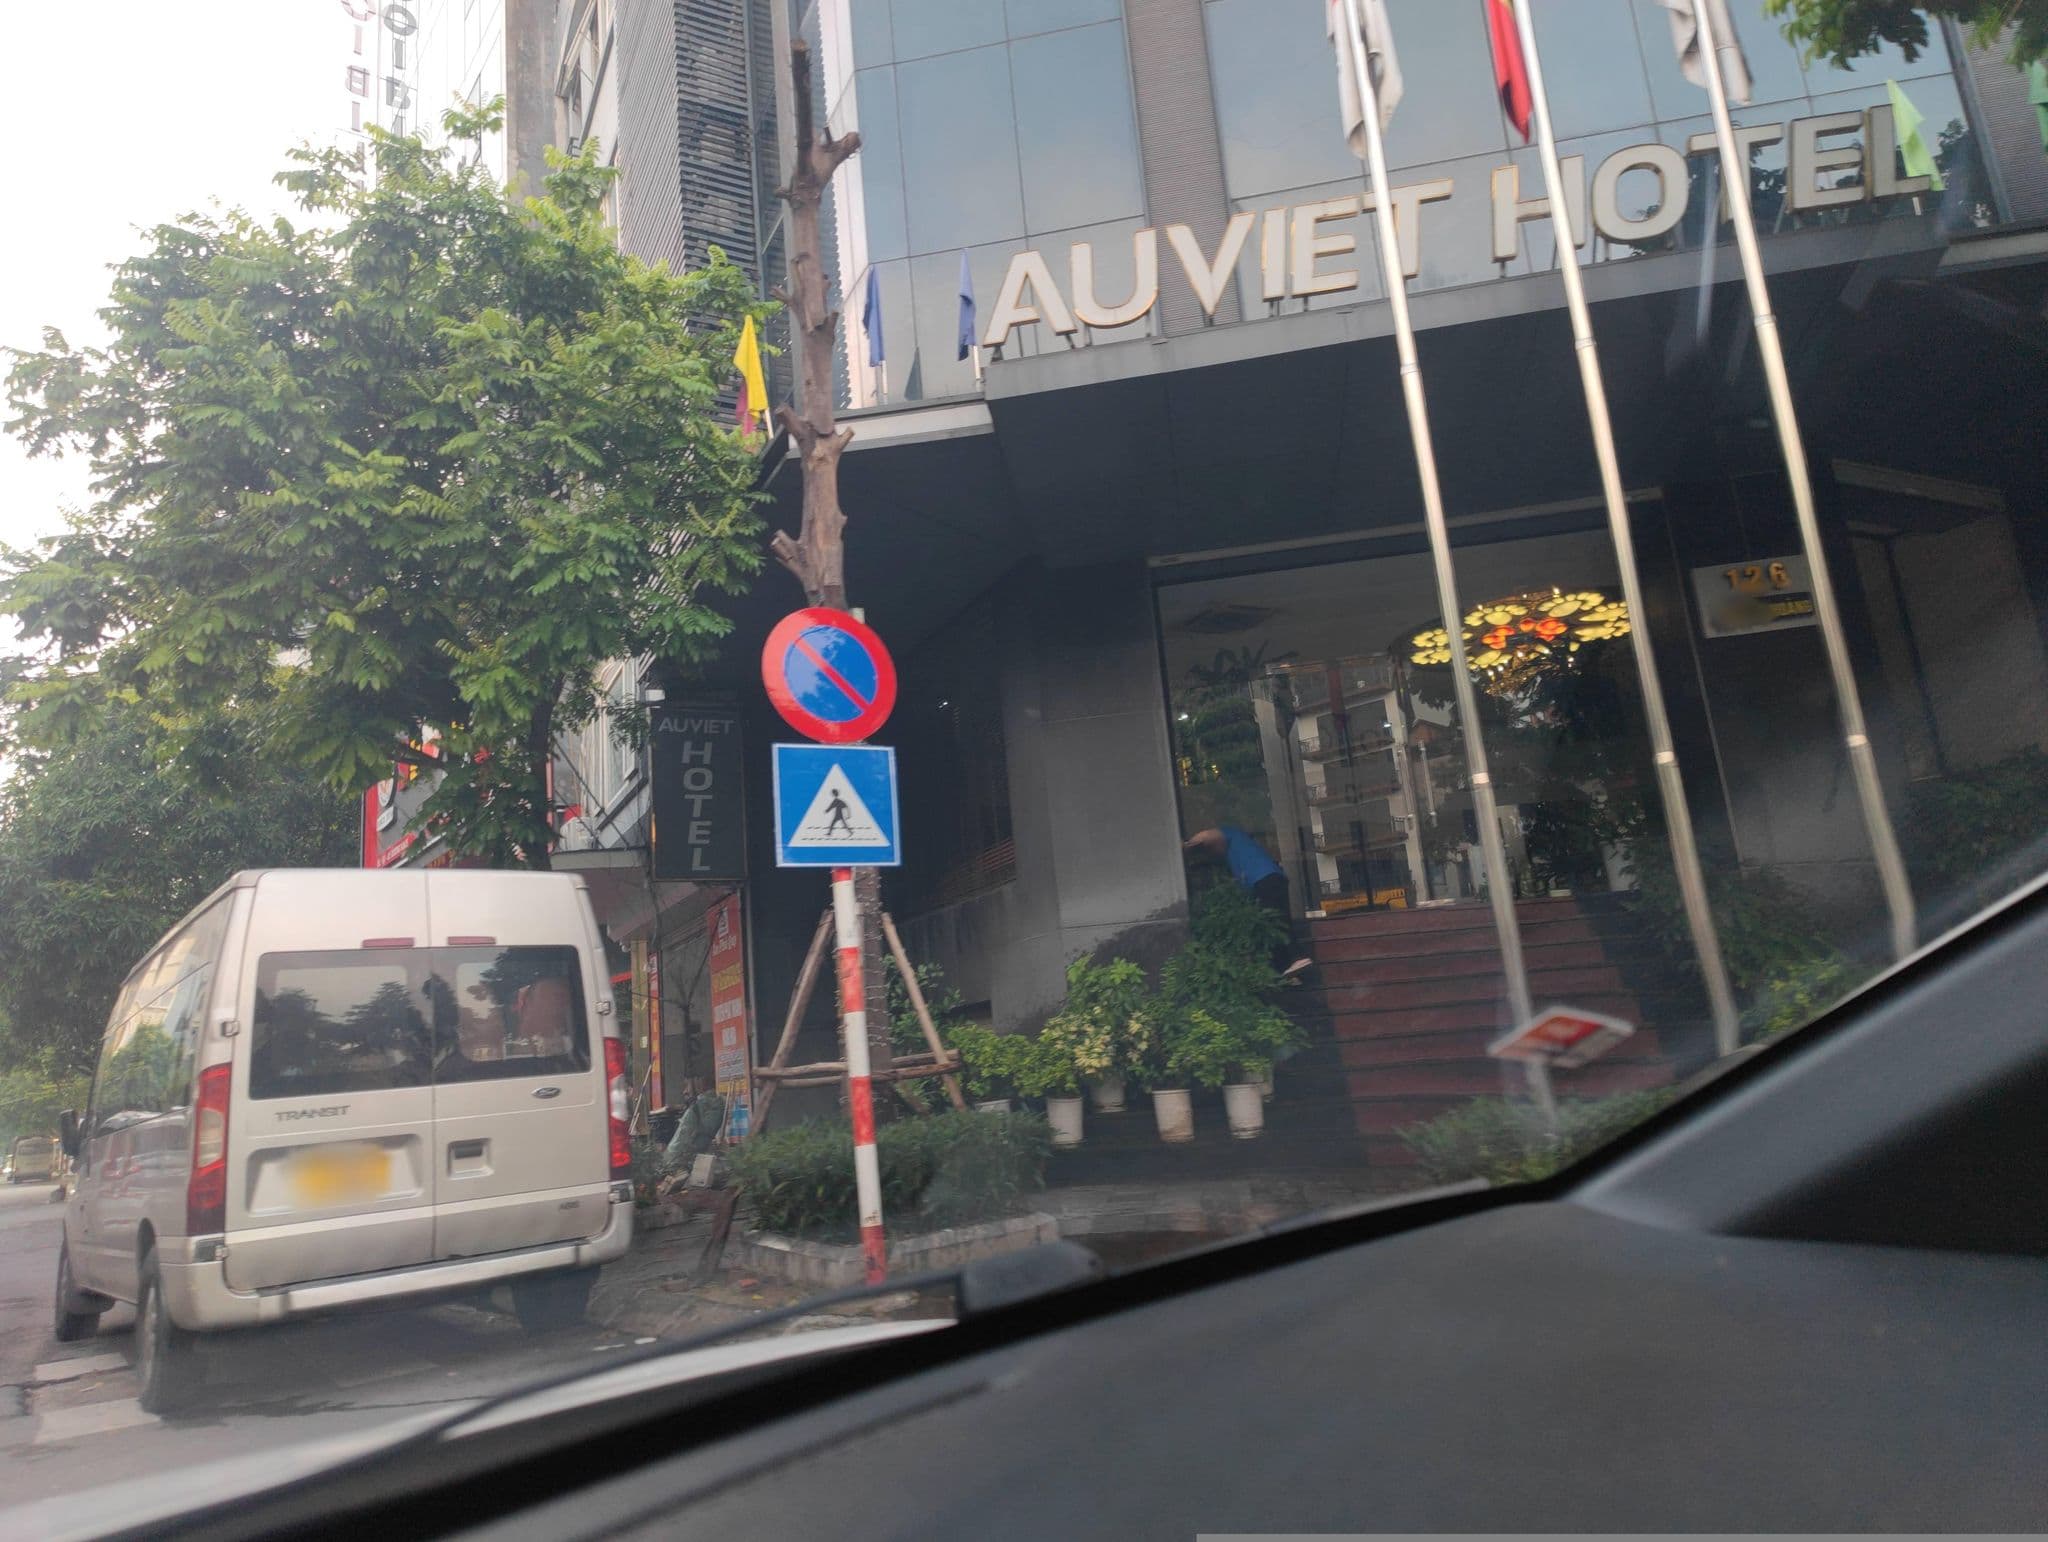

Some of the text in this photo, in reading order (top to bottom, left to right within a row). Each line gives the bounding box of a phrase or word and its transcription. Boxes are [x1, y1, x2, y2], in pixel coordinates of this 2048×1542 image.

[1491, 103, 1932, 263] HOTEL
[1724, 560, 1792, 592] 126
[659, 717, 734, 734] AUVIET
[681, 741, 713, 871] HOTEL
[274, 1104, 351, 1121] TRANSIT
